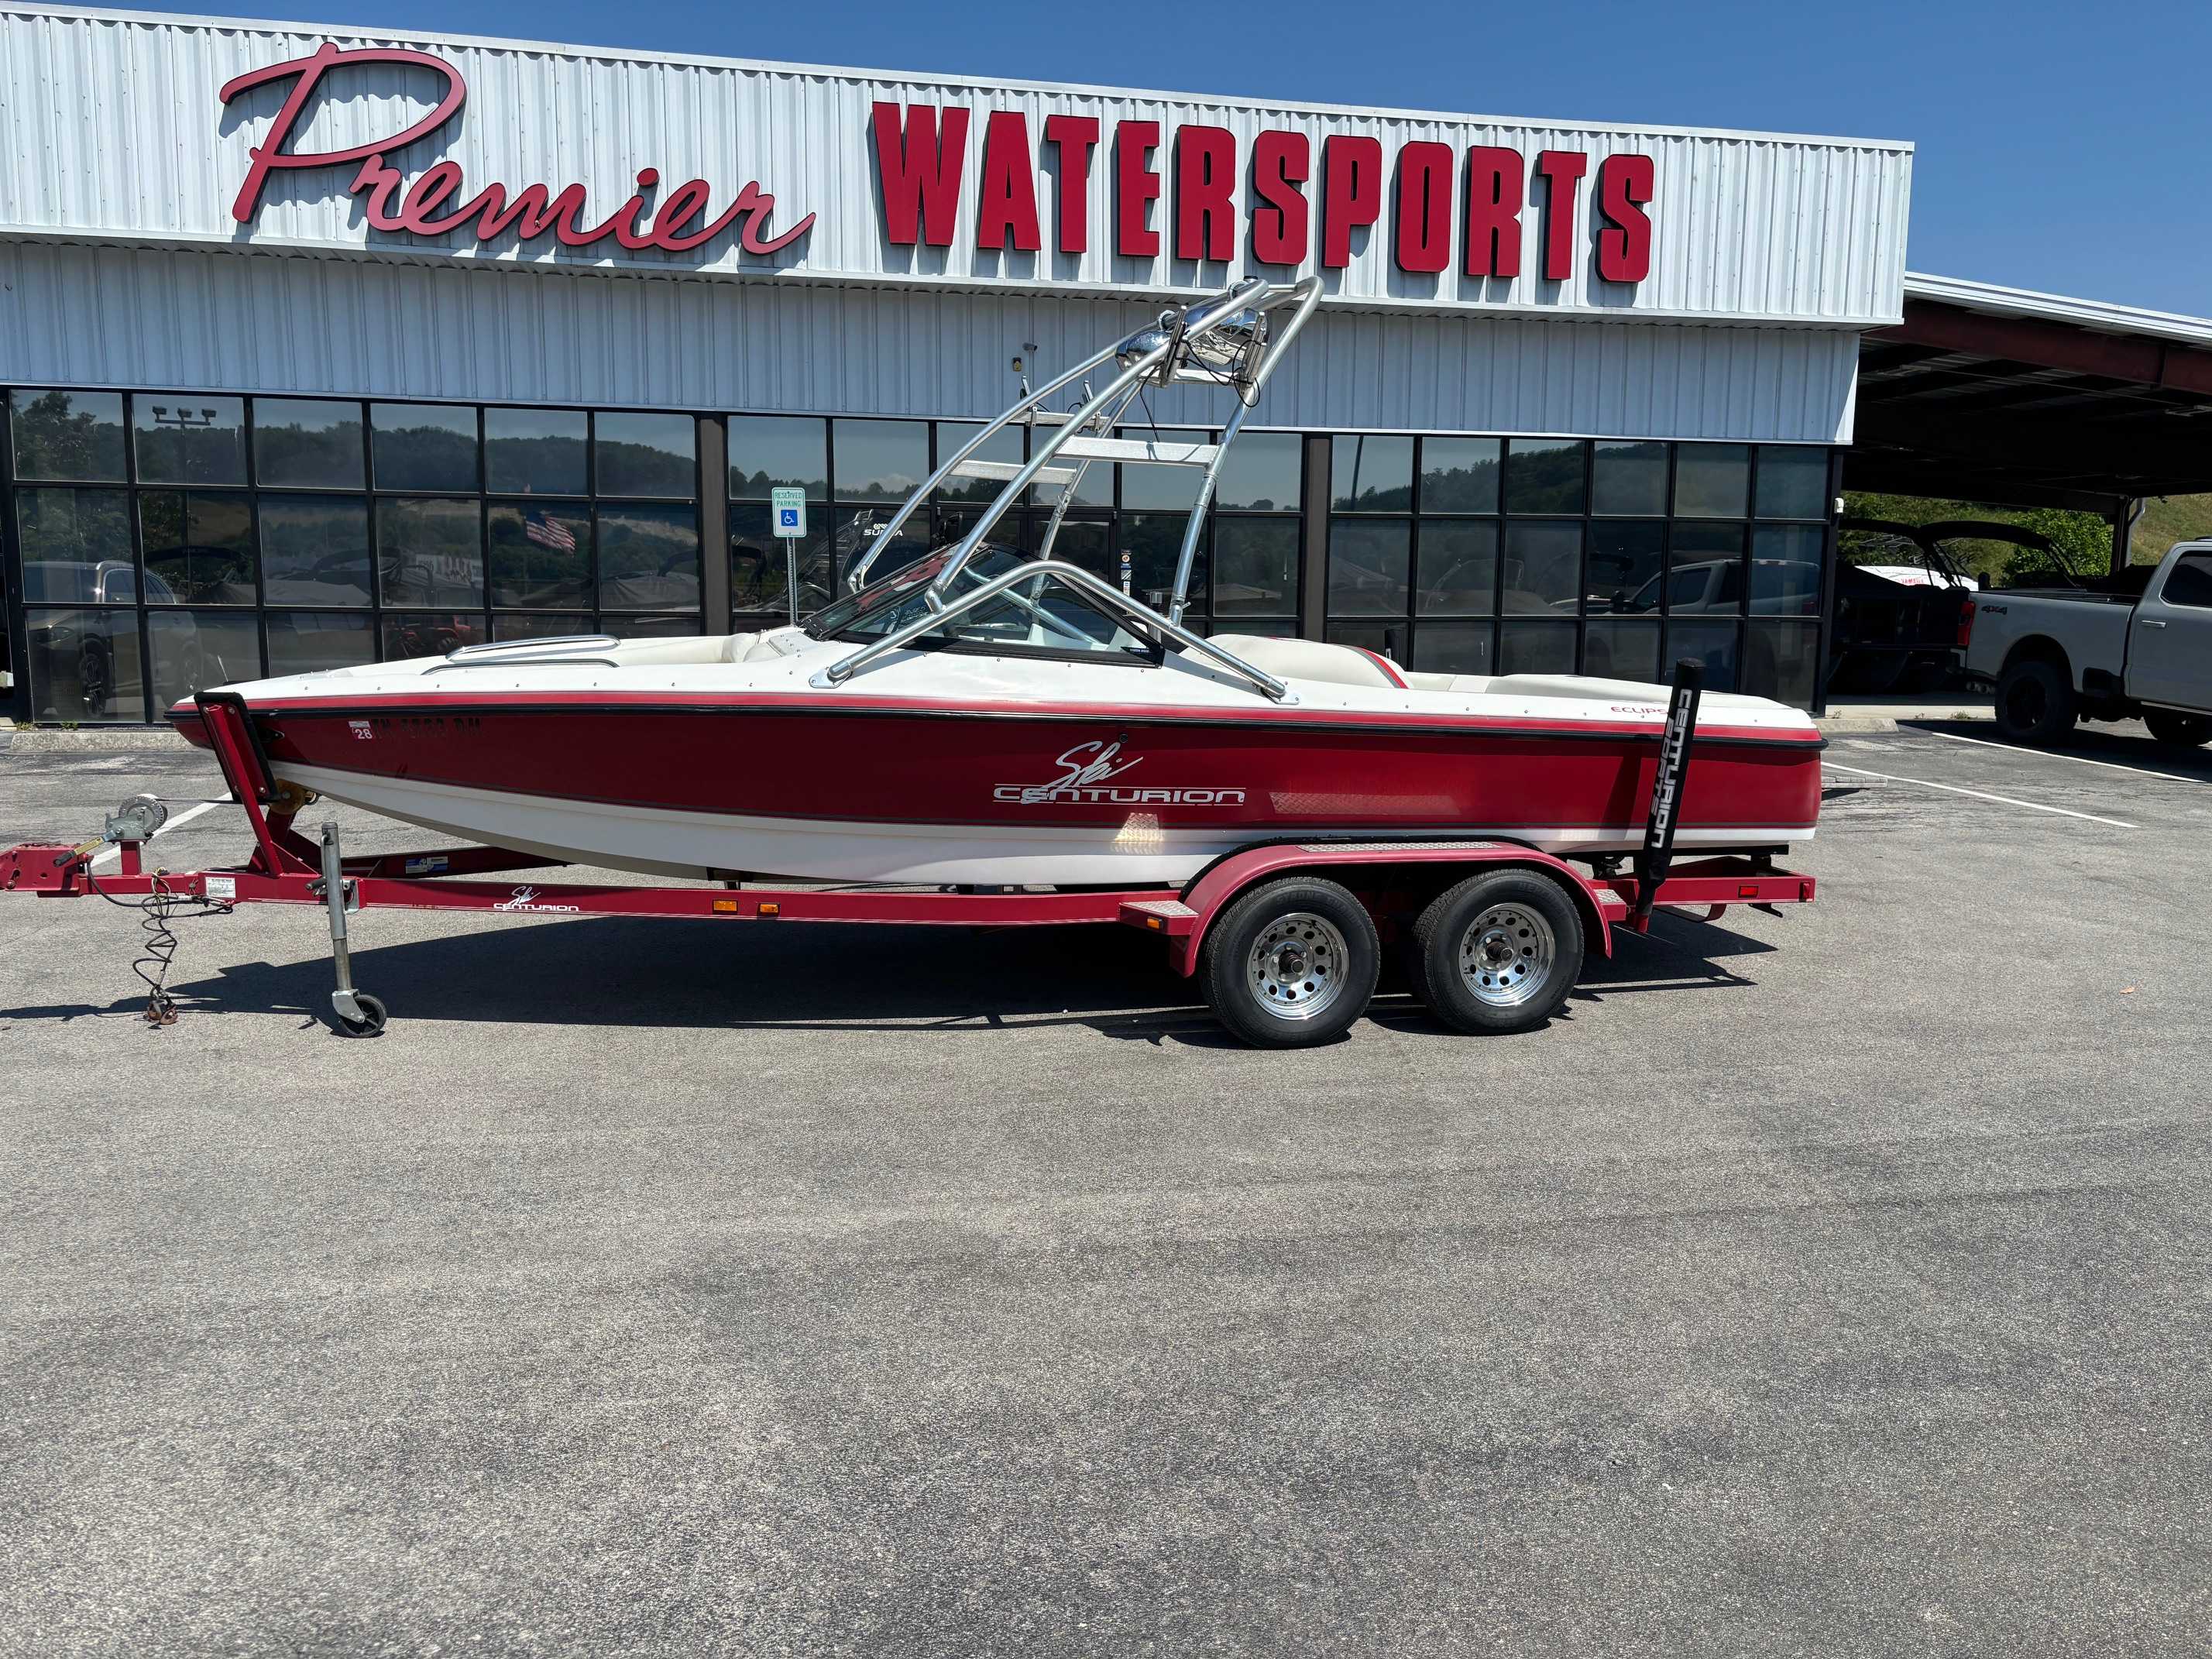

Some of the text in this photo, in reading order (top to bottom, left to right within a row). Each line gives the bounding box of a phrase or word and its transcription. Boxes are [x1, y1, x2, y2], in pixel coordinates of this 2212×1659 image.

[219, 41, 1654, 283] Premier WATERSPORTS
[355, 729, 373, 739] 28
[1021, 740, 1143, 804] Ski
[503, 886, 541, 911] Ski
